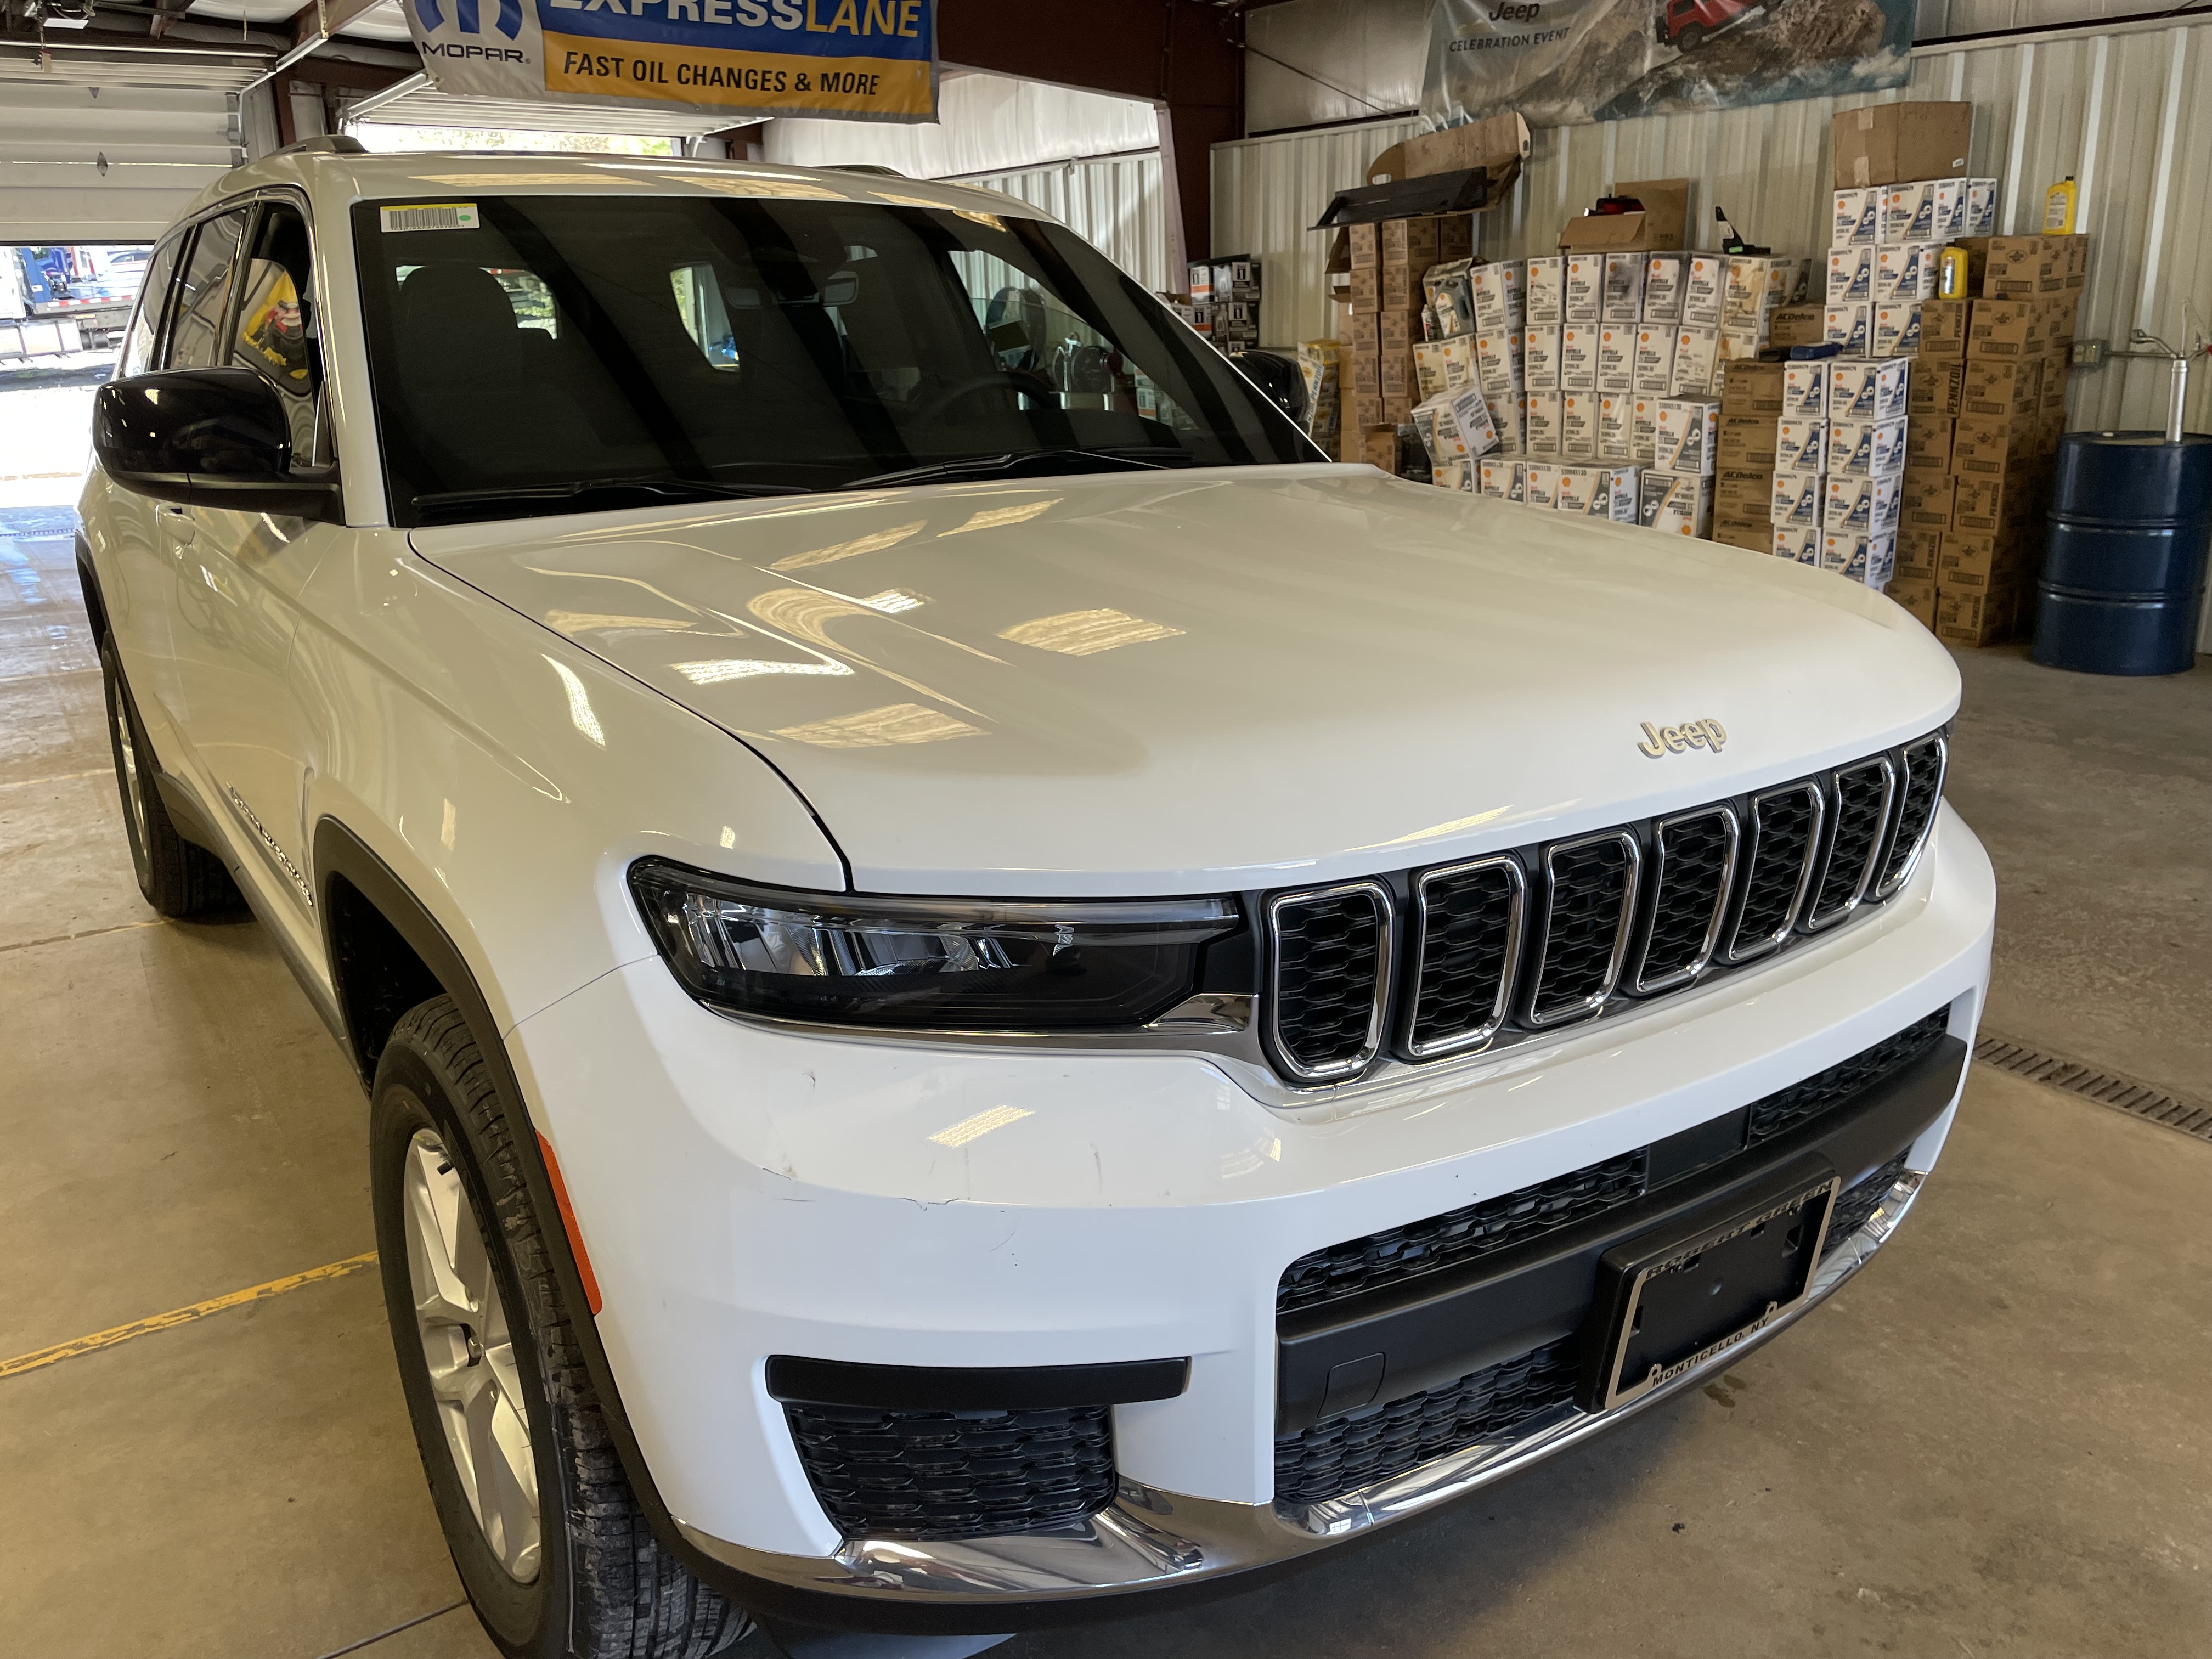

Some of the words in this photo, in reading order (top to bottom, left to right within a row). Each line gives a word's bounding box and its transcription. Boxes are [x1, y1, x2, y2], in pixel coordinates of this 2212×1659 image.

[550, 0, 923, 37] RESSLANE
[1489, 2, 1540, 22] Jeep
[1449, 34, 1530, 52] CELEBRATION
[1533, 27, 1570, 45] EVENT
[563, 51, 624, 77] FAST
[633, 59, 668, 83] OIL
[677, 63, 787, 92] CHANGES
[795, 72, 812, 92] &
[820, 72, 879, 95] MORE
[1637, 719, 1727, 759] Jeep
[1652, 1331, 1745, 1387] MONTICELLO,
[1751, 1316, 1769, 1334] NY
